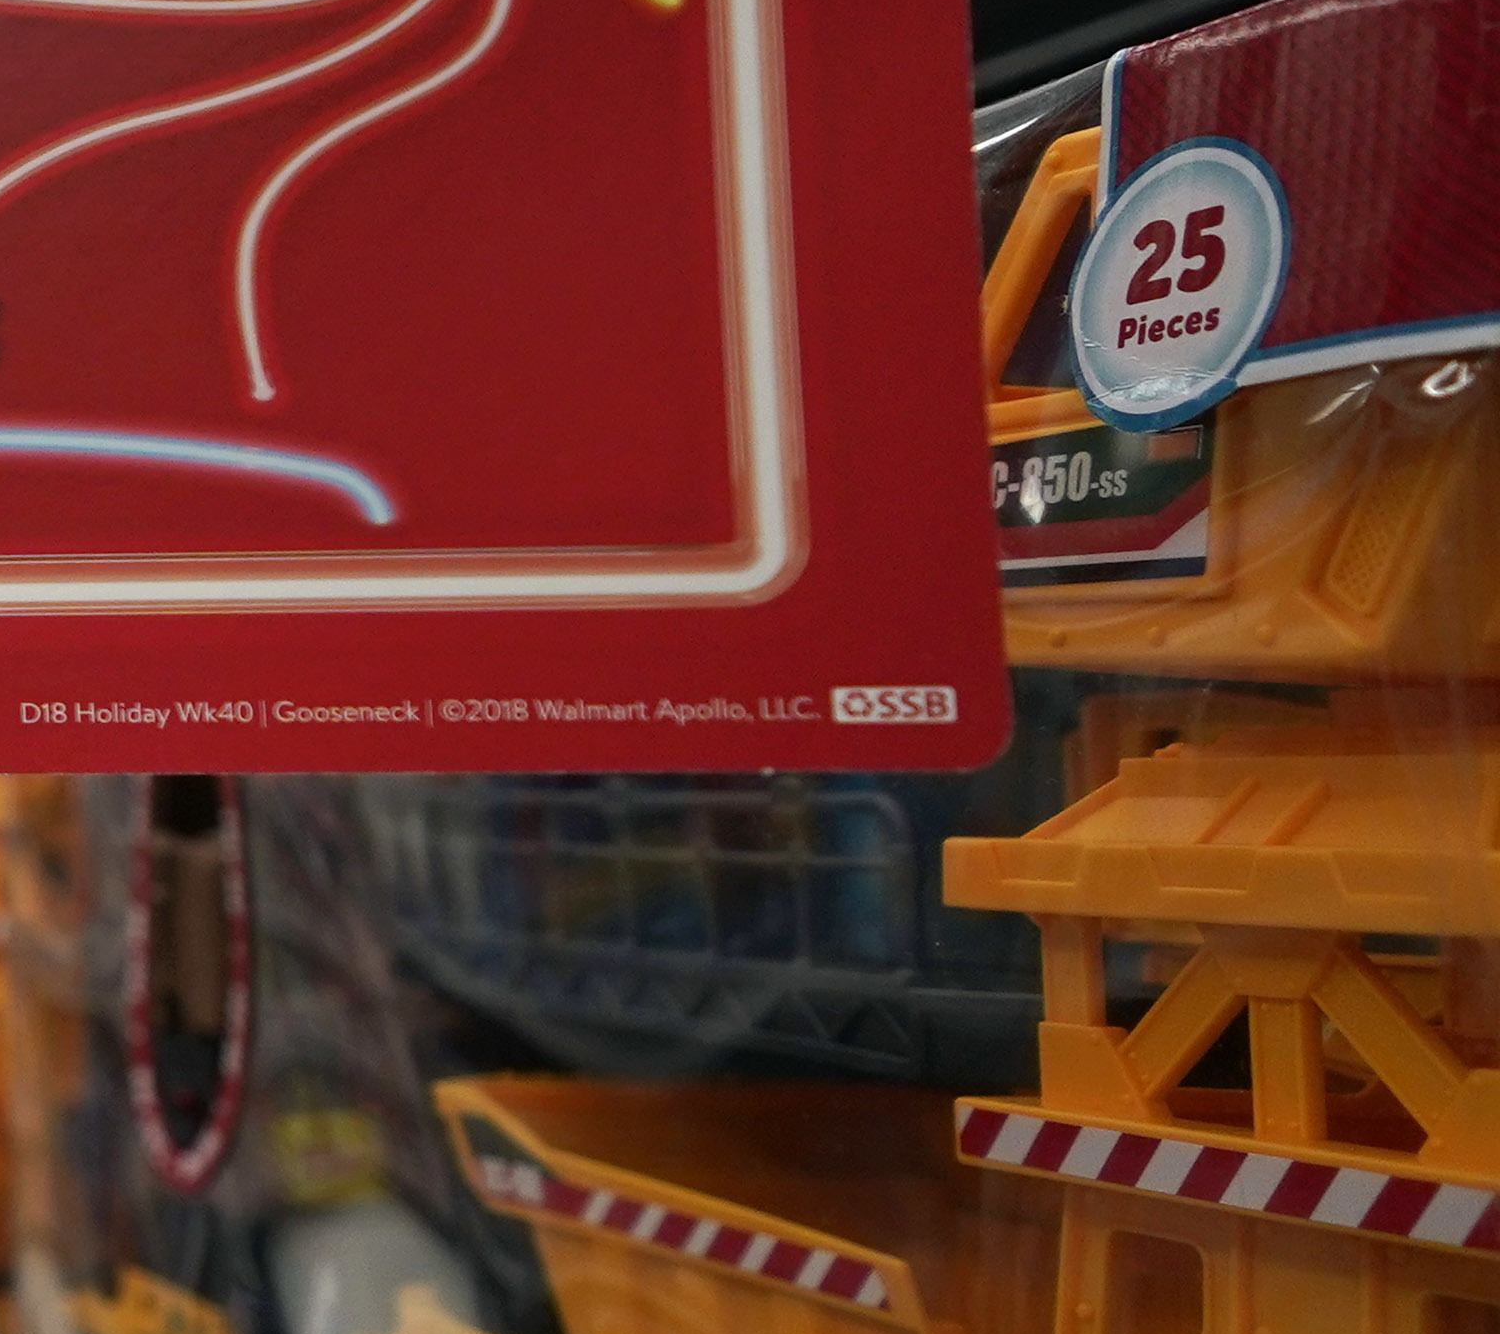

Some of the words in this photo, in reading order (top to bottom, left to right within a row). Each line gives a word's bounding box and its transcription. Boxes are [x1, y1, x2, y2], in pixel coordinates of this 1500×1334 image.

[1126, 205, 1225, 305] 25
[1117, 307, 1220, 349] Pieces
[20, 701, 68, 724] D18
[74, 701, 170, 729] Holiday
[175, 700, 254, 723] Wk40
[272, 699, 420, 723] Gooseneck
[534, 698, 648, 722] Walmart
[653, 697, 755, 727] Apollo,
[759, 695, 821, 721] LLC.
[878, 688, 951, 720] SSB
